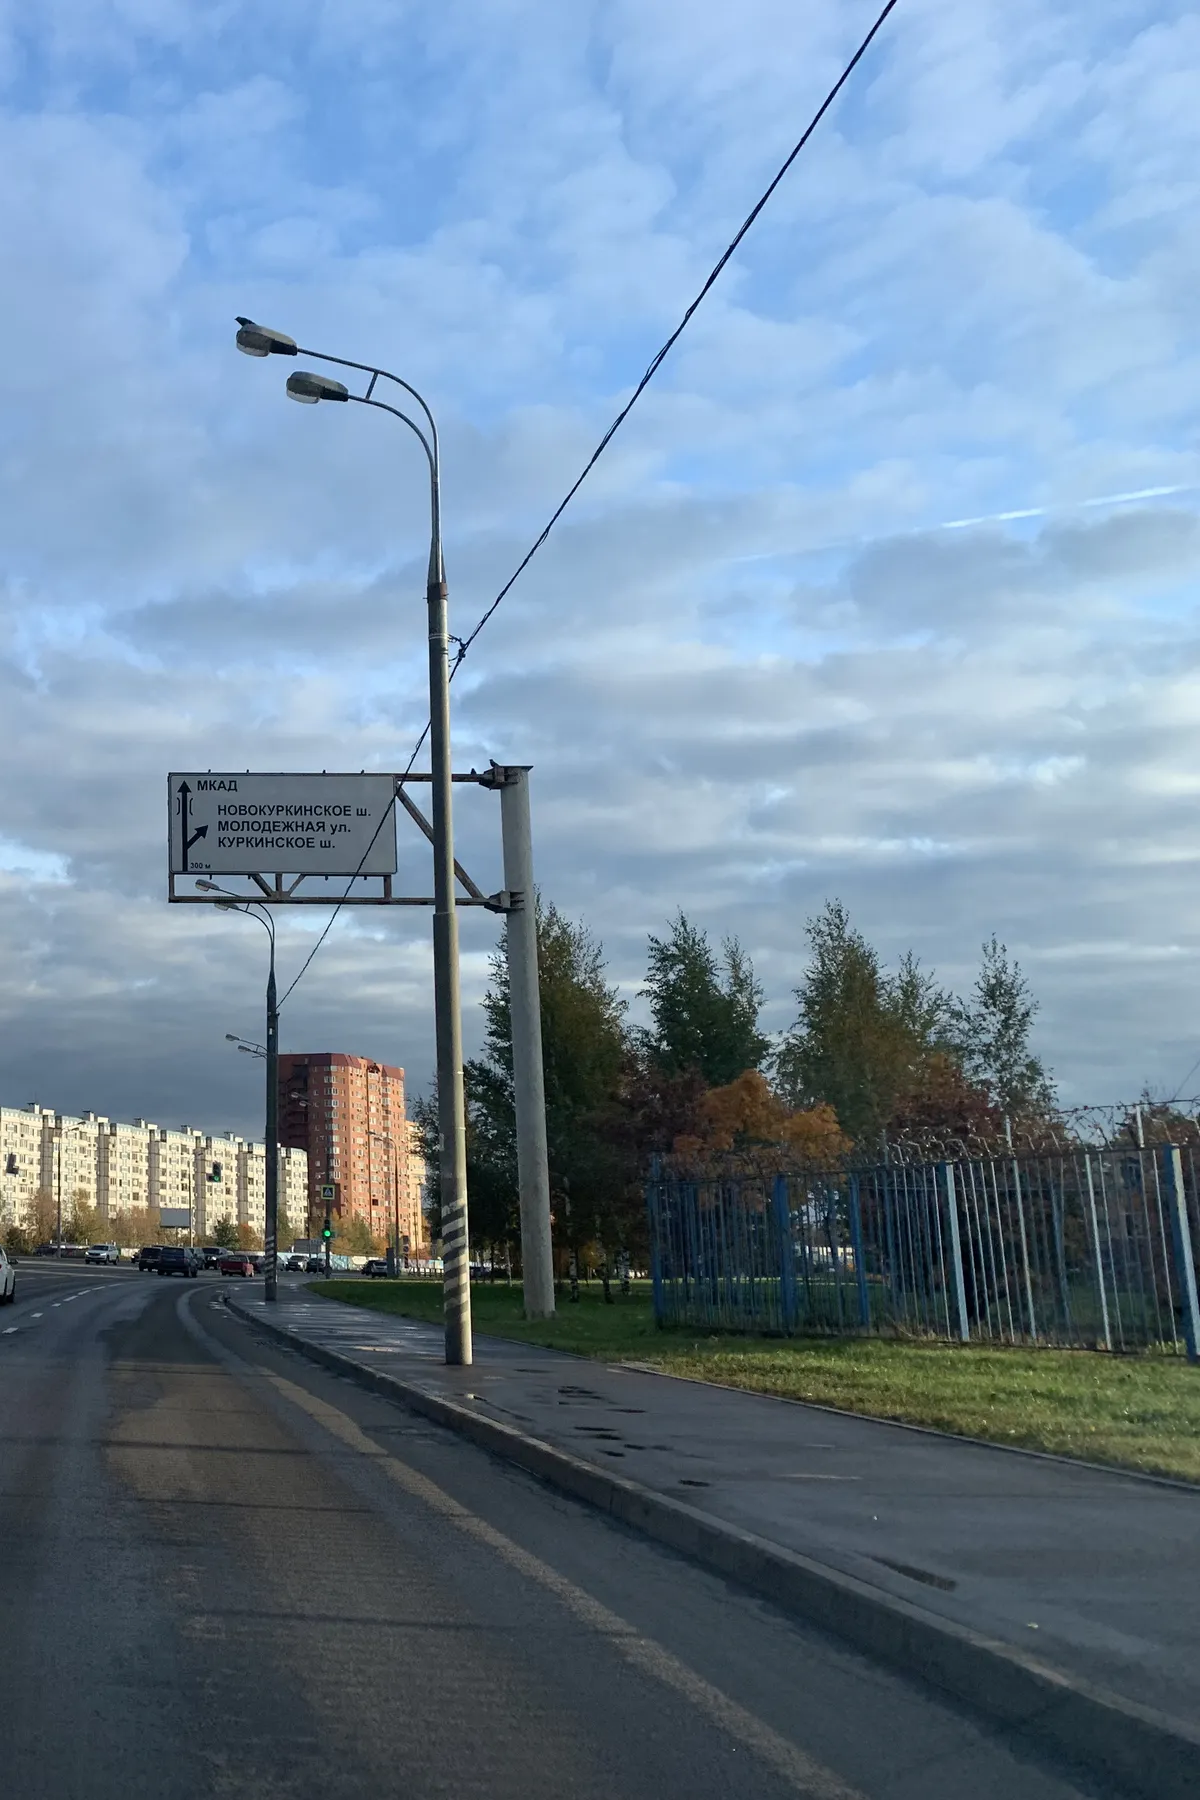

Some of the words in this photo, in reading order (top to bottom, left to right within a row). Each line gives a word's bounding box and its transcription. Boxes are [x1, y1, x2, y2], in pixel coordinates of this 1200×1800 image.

[196, 779, 238, 793] МКАД
[217, 804, 352, 817] НОВОКУРКИНСКОЕ
[355, 807, 371, 817] ш.
[217, 820, 326, 834] МОЛОДЕЖНАЯ
[329, 823, 351, 835] ул.
[217, 836, 316, 849] КУРКИНСКОЕ
[319, 840, 336, 849] ш.
